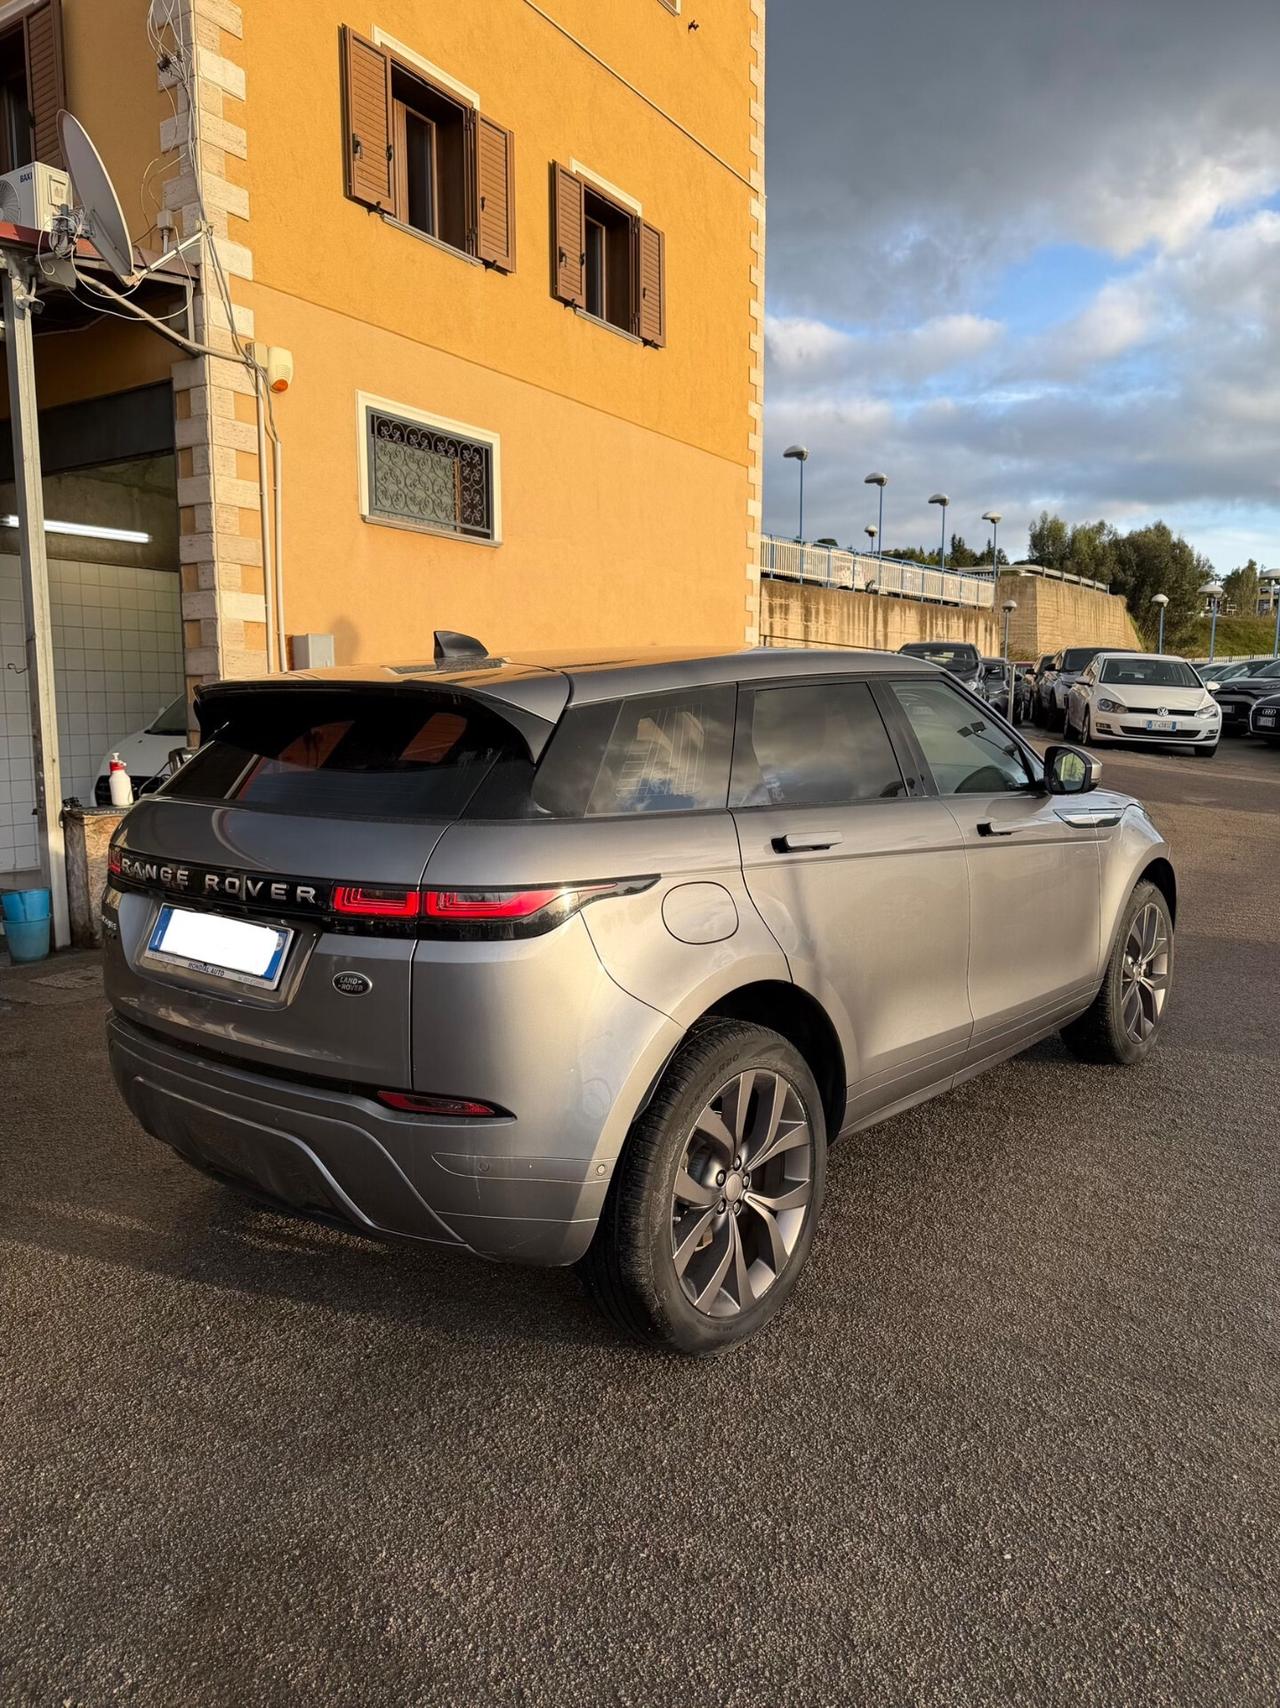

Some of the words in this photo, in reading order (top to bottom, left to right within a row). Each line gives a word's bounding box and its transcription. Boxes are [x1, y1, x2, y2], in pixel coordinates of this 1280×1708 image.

[20, 172, 33, 183] BAXI
[121, 858, 189, 886] RANGE
[204, 874, 316, 904] ROVER
[210, 967, 225, 977] AUTO
